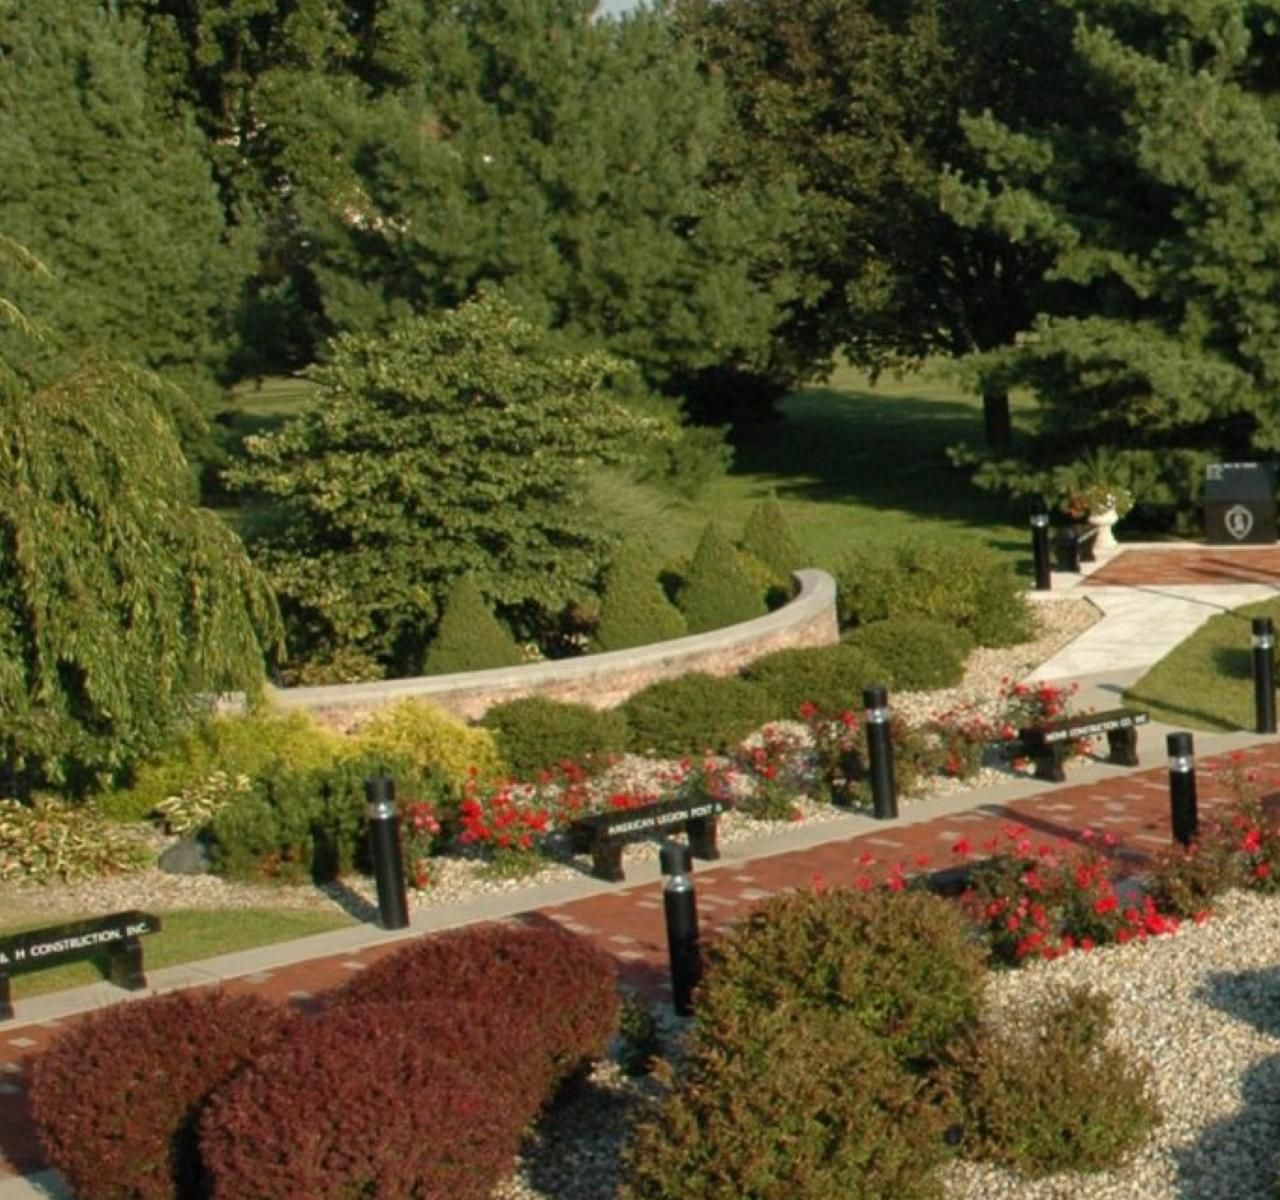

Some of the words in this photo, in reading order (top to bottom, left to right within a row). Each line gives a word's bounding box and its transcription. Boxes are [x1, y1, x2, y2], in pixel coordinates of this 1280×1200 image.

[608, 818, 655, 835] AMERICAN
[657, 811, 689, 826] LEGION
[691, 804, 713, 818] POST
[15, 949, 26, 961] H
